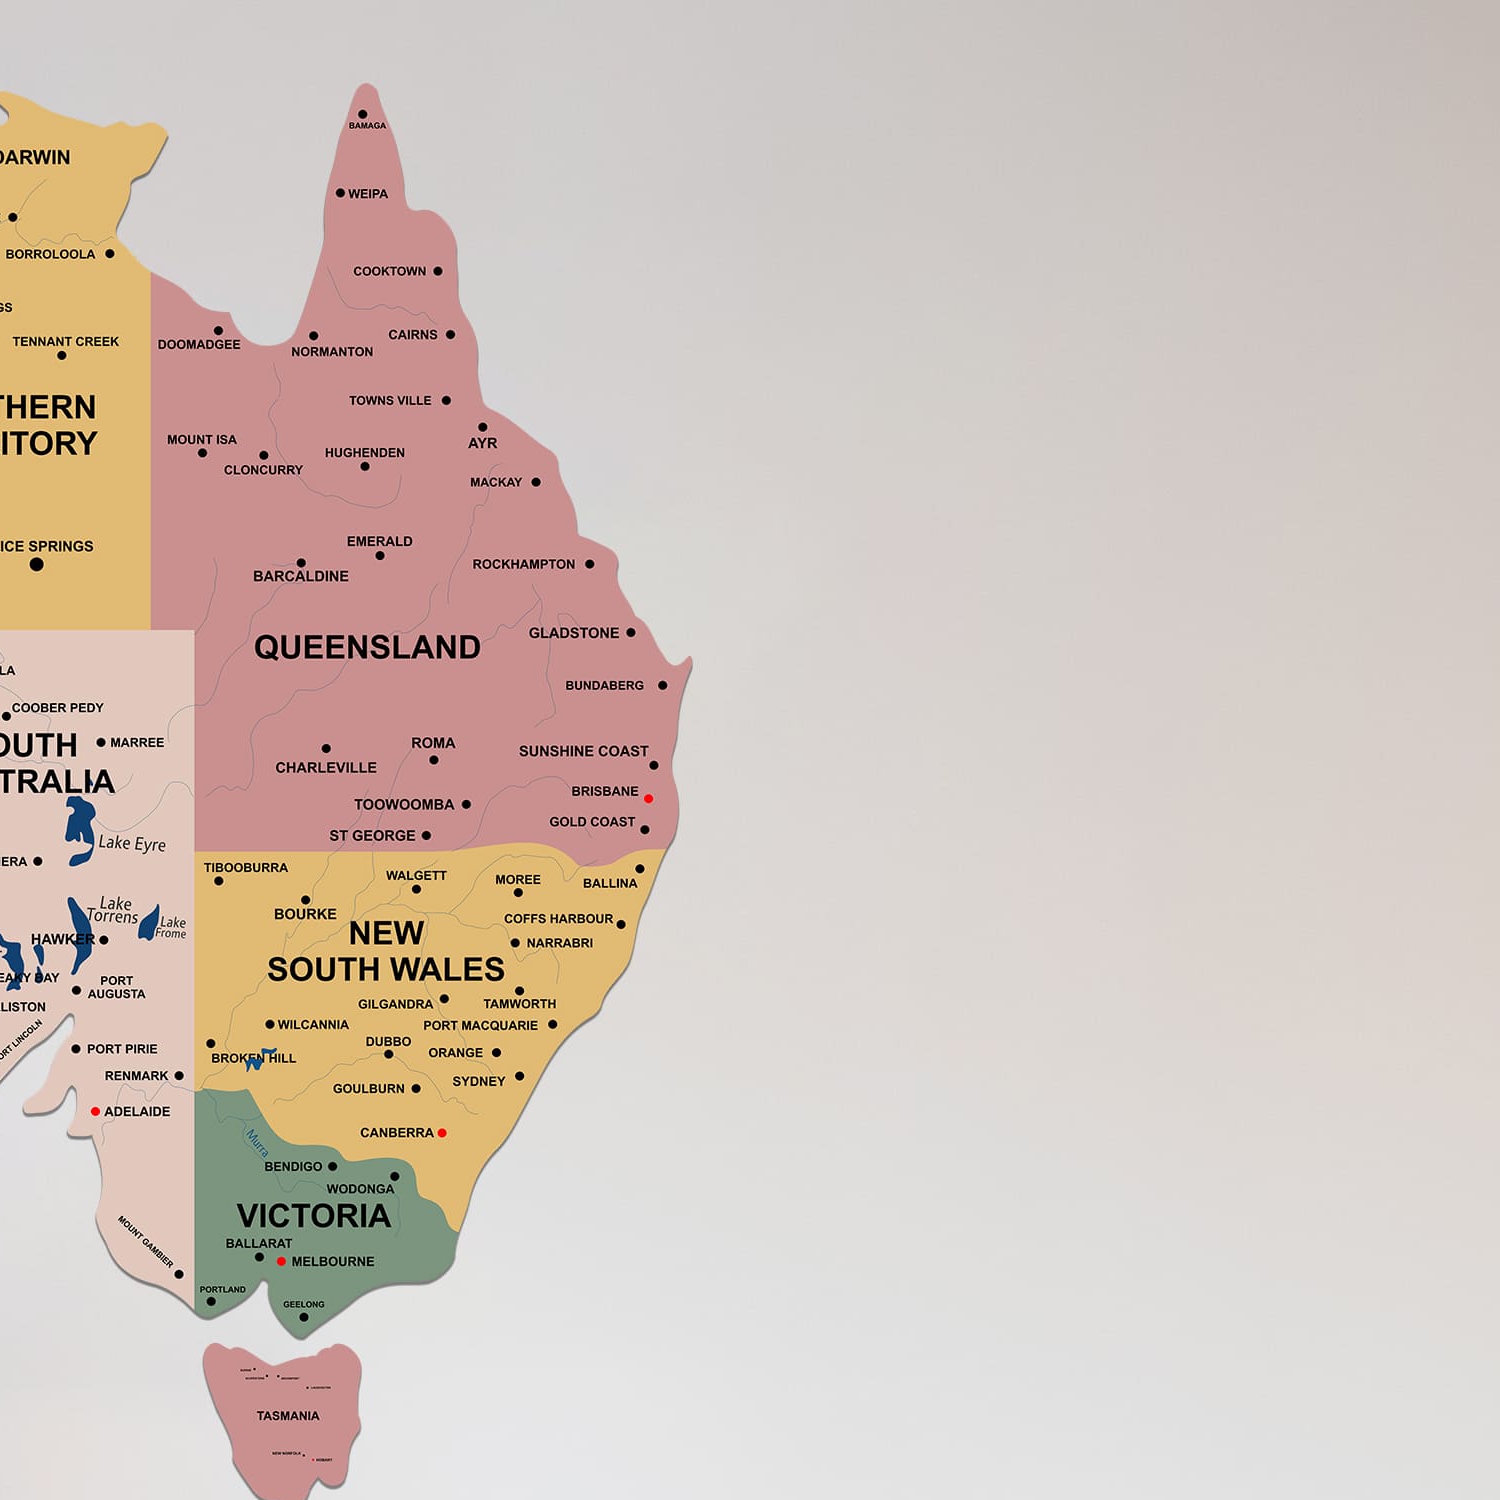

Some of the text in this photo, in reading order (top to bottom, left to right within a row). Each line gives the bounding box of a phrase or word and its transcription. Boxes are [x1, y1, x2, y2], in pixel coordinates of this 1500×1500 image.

[349, 189, 388, 198] WEIPA
[7, 250, 95, 259] BORROLOOLA
[354, 267, 425, 276] COOKTOWN
[389, 330, 437, 339] CAIRNS
[13, 337, 118, 346] TENNANT CREEK
[159, 340, 240, 349] DOOMADGEE
[292, 347, 372, 356] NORMANTON
[350, 396, 430, 405] TOWNS VILLE
[168, 435, 236, 444] MOUNT ISA
[469, 438, 497, 448] AYR
[326, 448, 404, 457] HUGHENDEN
[225, 465, 302, 474] CLONCURRY
[471, 478, 521, 486] MACKAY
[348, 536, 412, 546] EMERALD
[29, 541, 93, 551] SPRINGS
[474, 559, 574, 569] ROCKHAMPTON
[254, 571, 348, 581] BARCALDINE
[530, 628, 619, 638] GLADSTONE
[255, 635, 480, 660] QUEENSLAND
[566, 681, 643, 690] BUNDABERG
[13, 703, 103, 712] COOBER PEDY
[111, 738, 164, 747] MARREE
[412, 738, 455, 748] ROMA
[520, 746, 648, 756] SUNSHINE COAST
[276, 762, 376, 773] CHARLEVILLE
[573, 787, 638, 796] BRISBANE
[355, 799, 454, 810] TOOWOOMBA
[550, 817, 635, 826] GOLD COAST
[331, 830, 415, 841] ST GEORGE
[99, 835, 166, 854] Lake Eyre
[204, 863, 288, 872] TIBOOBURRA
[387, 871, 446, 880] WALGETT
[496, 875, 540, 884] MOREE
[584, 879, 637, 888] BALLINA
[100, 896, 132, 911] Lake
[87, 907, 139, 925] Torrens
[275, 909, 336, 919] BOURKE
[505, 914, 613, 923] COFFS HARBOUR
[160, 916, 187, 928] Lake
[155, 926, 187, 939] Frome
[351, 921, 424, 944] NEW
[32, 933, 95, 944] HAWKER
[528, 938, 592, 947] NARRABRI
[268, 957, 504, 981] SOUTH WALES
[35, 972, 59, 982] BAY
[101, 976, 133, 985] PORT
[88, 989, 145, 998] AUGUSTA
[359, 1000, 433, 1009] GILGANDRA
[484, 999, 555, 1008] TAMWORTH
[278, 1020, 348, 1029] WILCANNIA
[424, 1021, 537, 1030] PORT MACQUARIE
[11, 1019, 43, 1048] LINCOLN
[367, 1037, 411, 1046] DUBBO
[88, 1044, 157, 1053] PORT PIRIE
[429, 1048, 482, 1057] ORANGE
[212, 1053, 295, 1063] BROKEN HILL
[106, 1071, 168, 1080] RENMARK
[453, 1077, 505, 1086] SYDNEY
[334, 1084, 404, 1093] GOULBURN
[105, 1107, 169, 1116] ADELAIDE
[361, 1128, 434, 1137] CANBERRA
[265, 1162, 322, 1171] BENDIGO
[327, 1184, 394, 1193] WODONGA
[237, 1203, 391, 1227] VICTORIA
[117, 1215, 174, 1269] MOUNT GAMBIER
[227, 1239, 292, 1248] BALLARAT
[293, 1257, 374, 1266] MELBOURNE
[258, 1411, 319, 1420] TASMANIA
